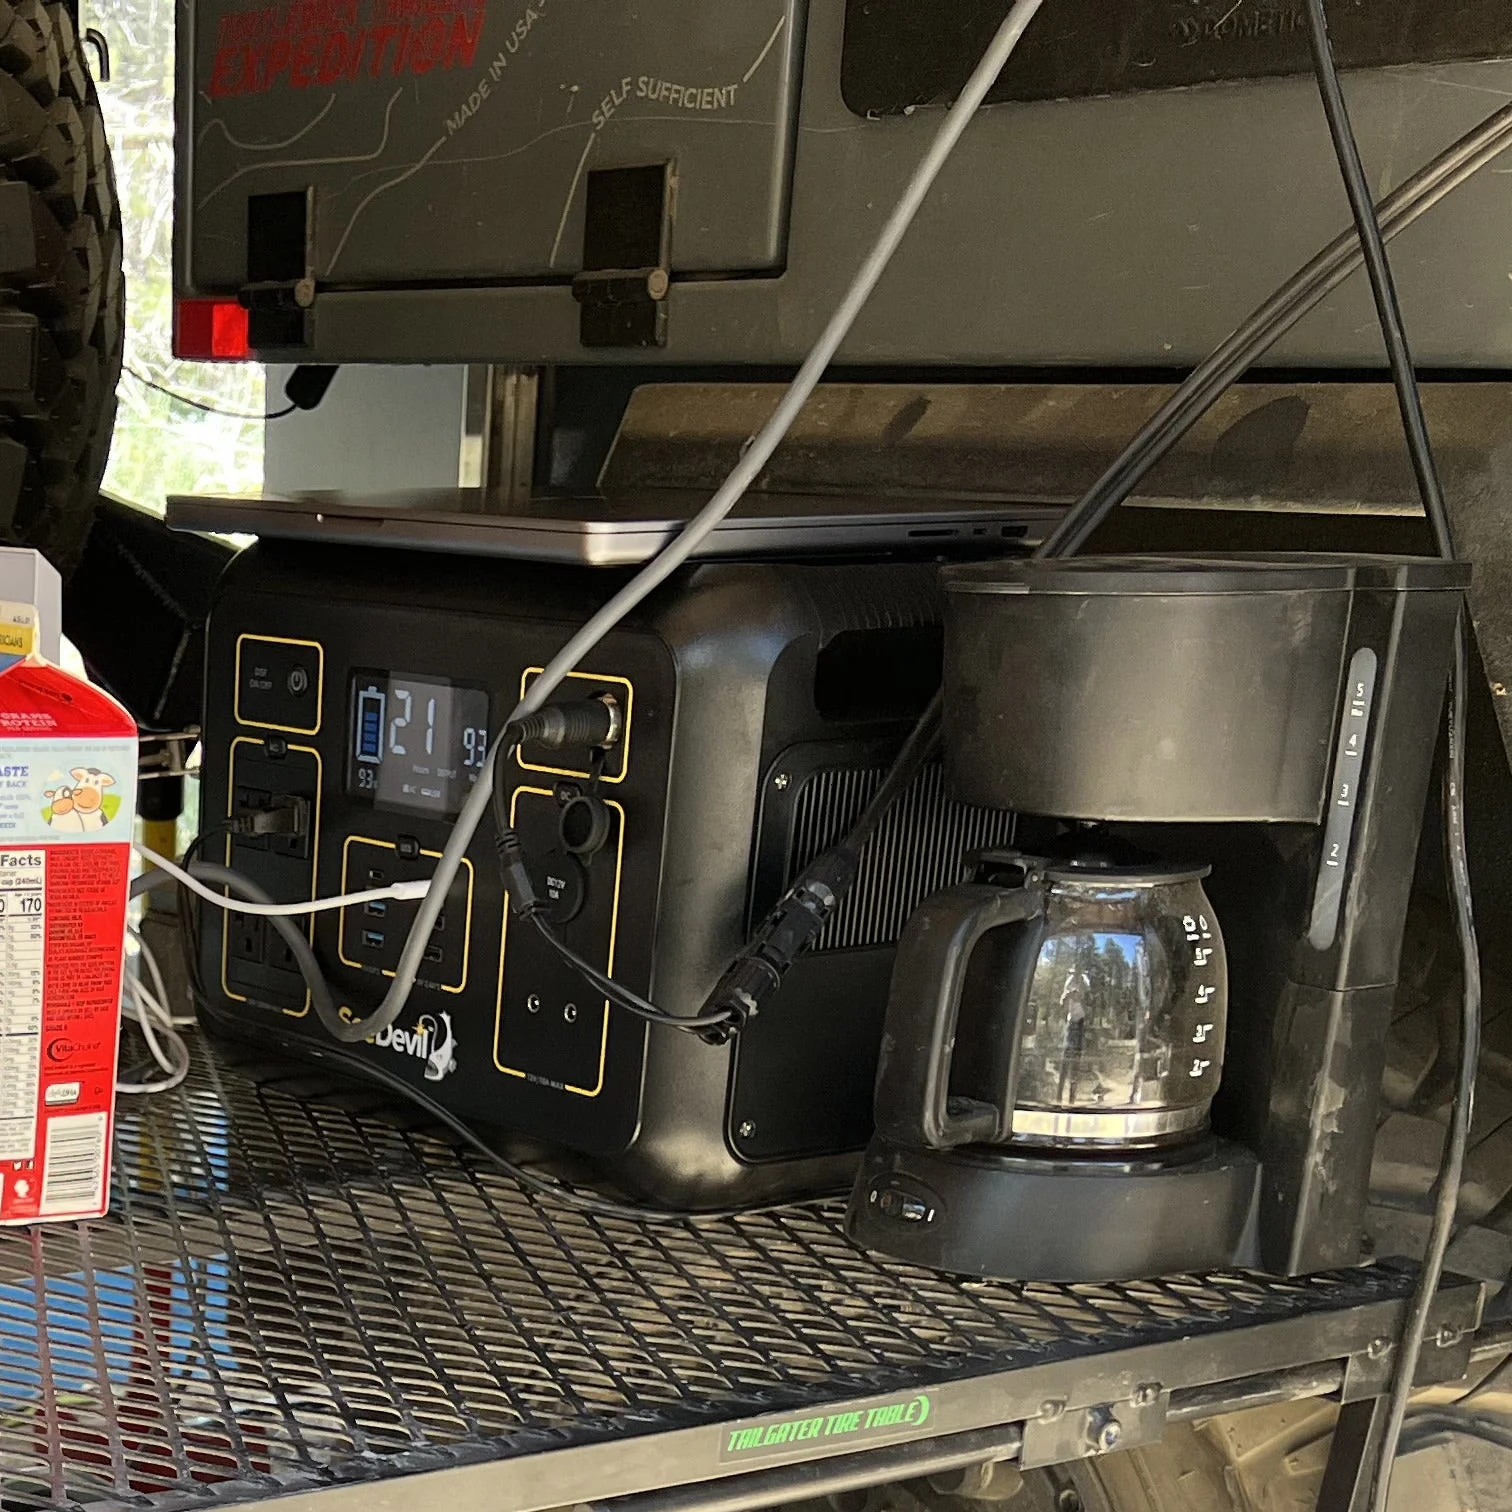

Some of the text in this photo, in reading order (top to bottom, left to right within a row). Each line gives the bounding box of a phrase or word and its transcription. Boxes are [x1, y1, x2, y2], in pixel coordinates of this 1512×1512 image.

[208, 12, 486, 98] EXPEDITION
[445, 8, 538, 136] MADE IN USA
[591, 76, 738, 130] SELF SUFFICIENT
[1356, 683, 1364, 697] 5
[389, 689, 436, 755] 21
[1348, 733, 1357, 747] 4
[6, 780, 27, 788] BACK
[1340, 784, 1348, 798] 3
[1331, 844, 1339, 857] 2
[0, 854, 42, 867] Facts
[20, 898, 42, 912] 170
[727, 1401, 920, 1451] TAILGATER TIRE TABLE
